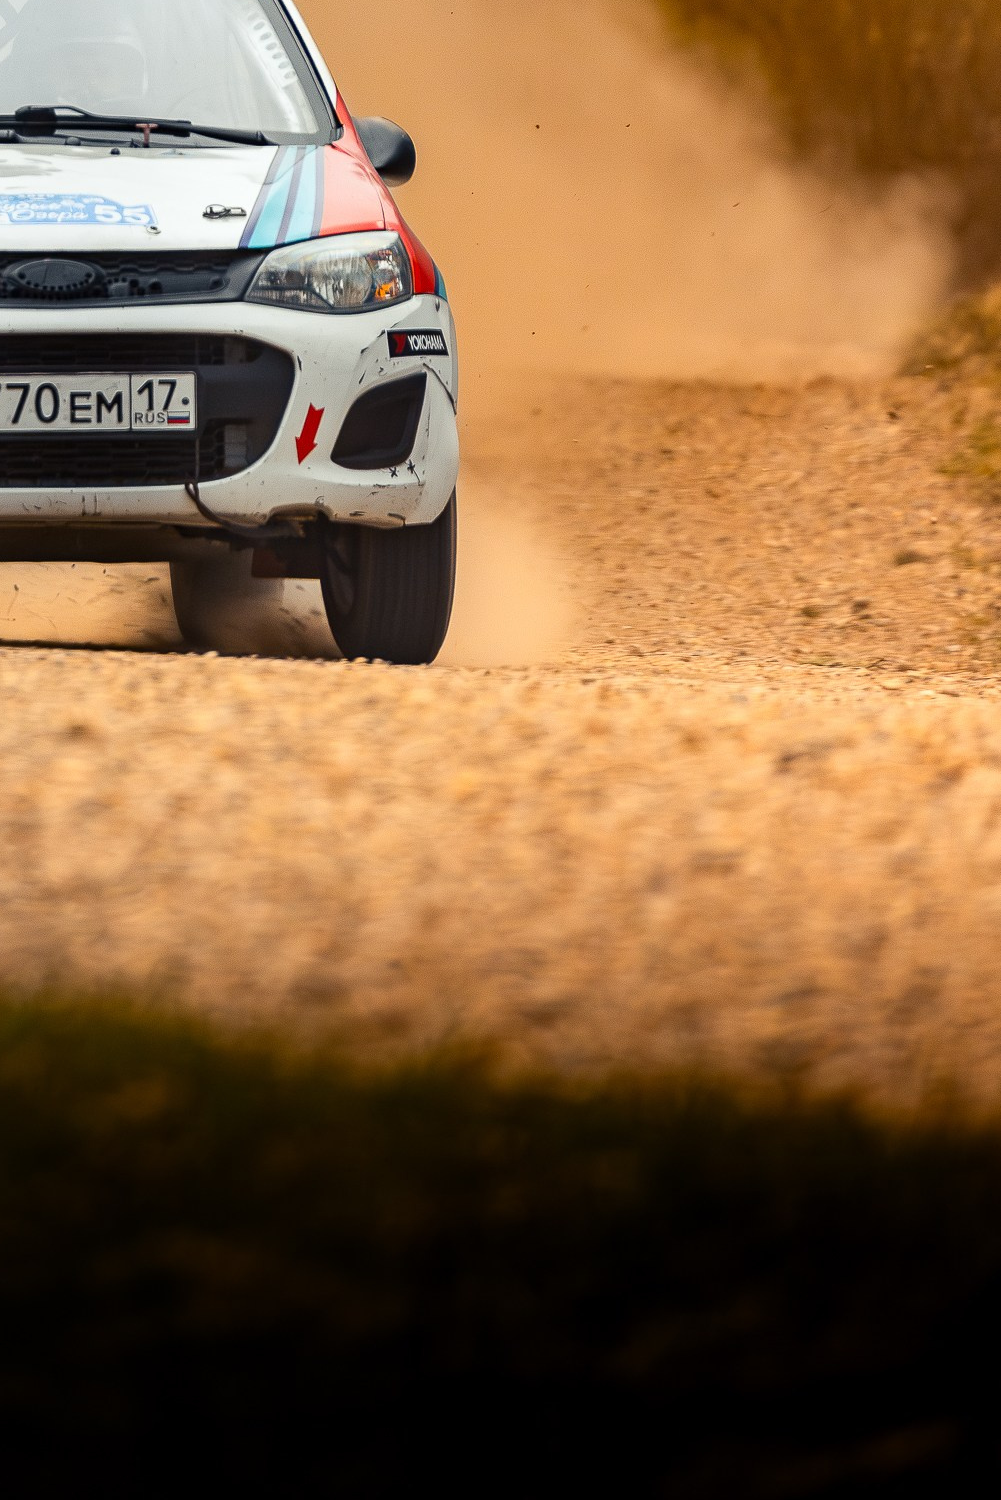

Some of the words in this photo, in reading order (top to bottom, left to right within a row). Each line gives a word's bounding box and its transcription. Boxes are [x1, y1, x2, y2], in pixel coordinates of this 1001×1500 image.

[94, 204, 152, 225] 55
[407, 334, 445, 351] YOKOHAMA
[136, 378, 178, 412] 17
[133, 411, 166, 425] RUS
